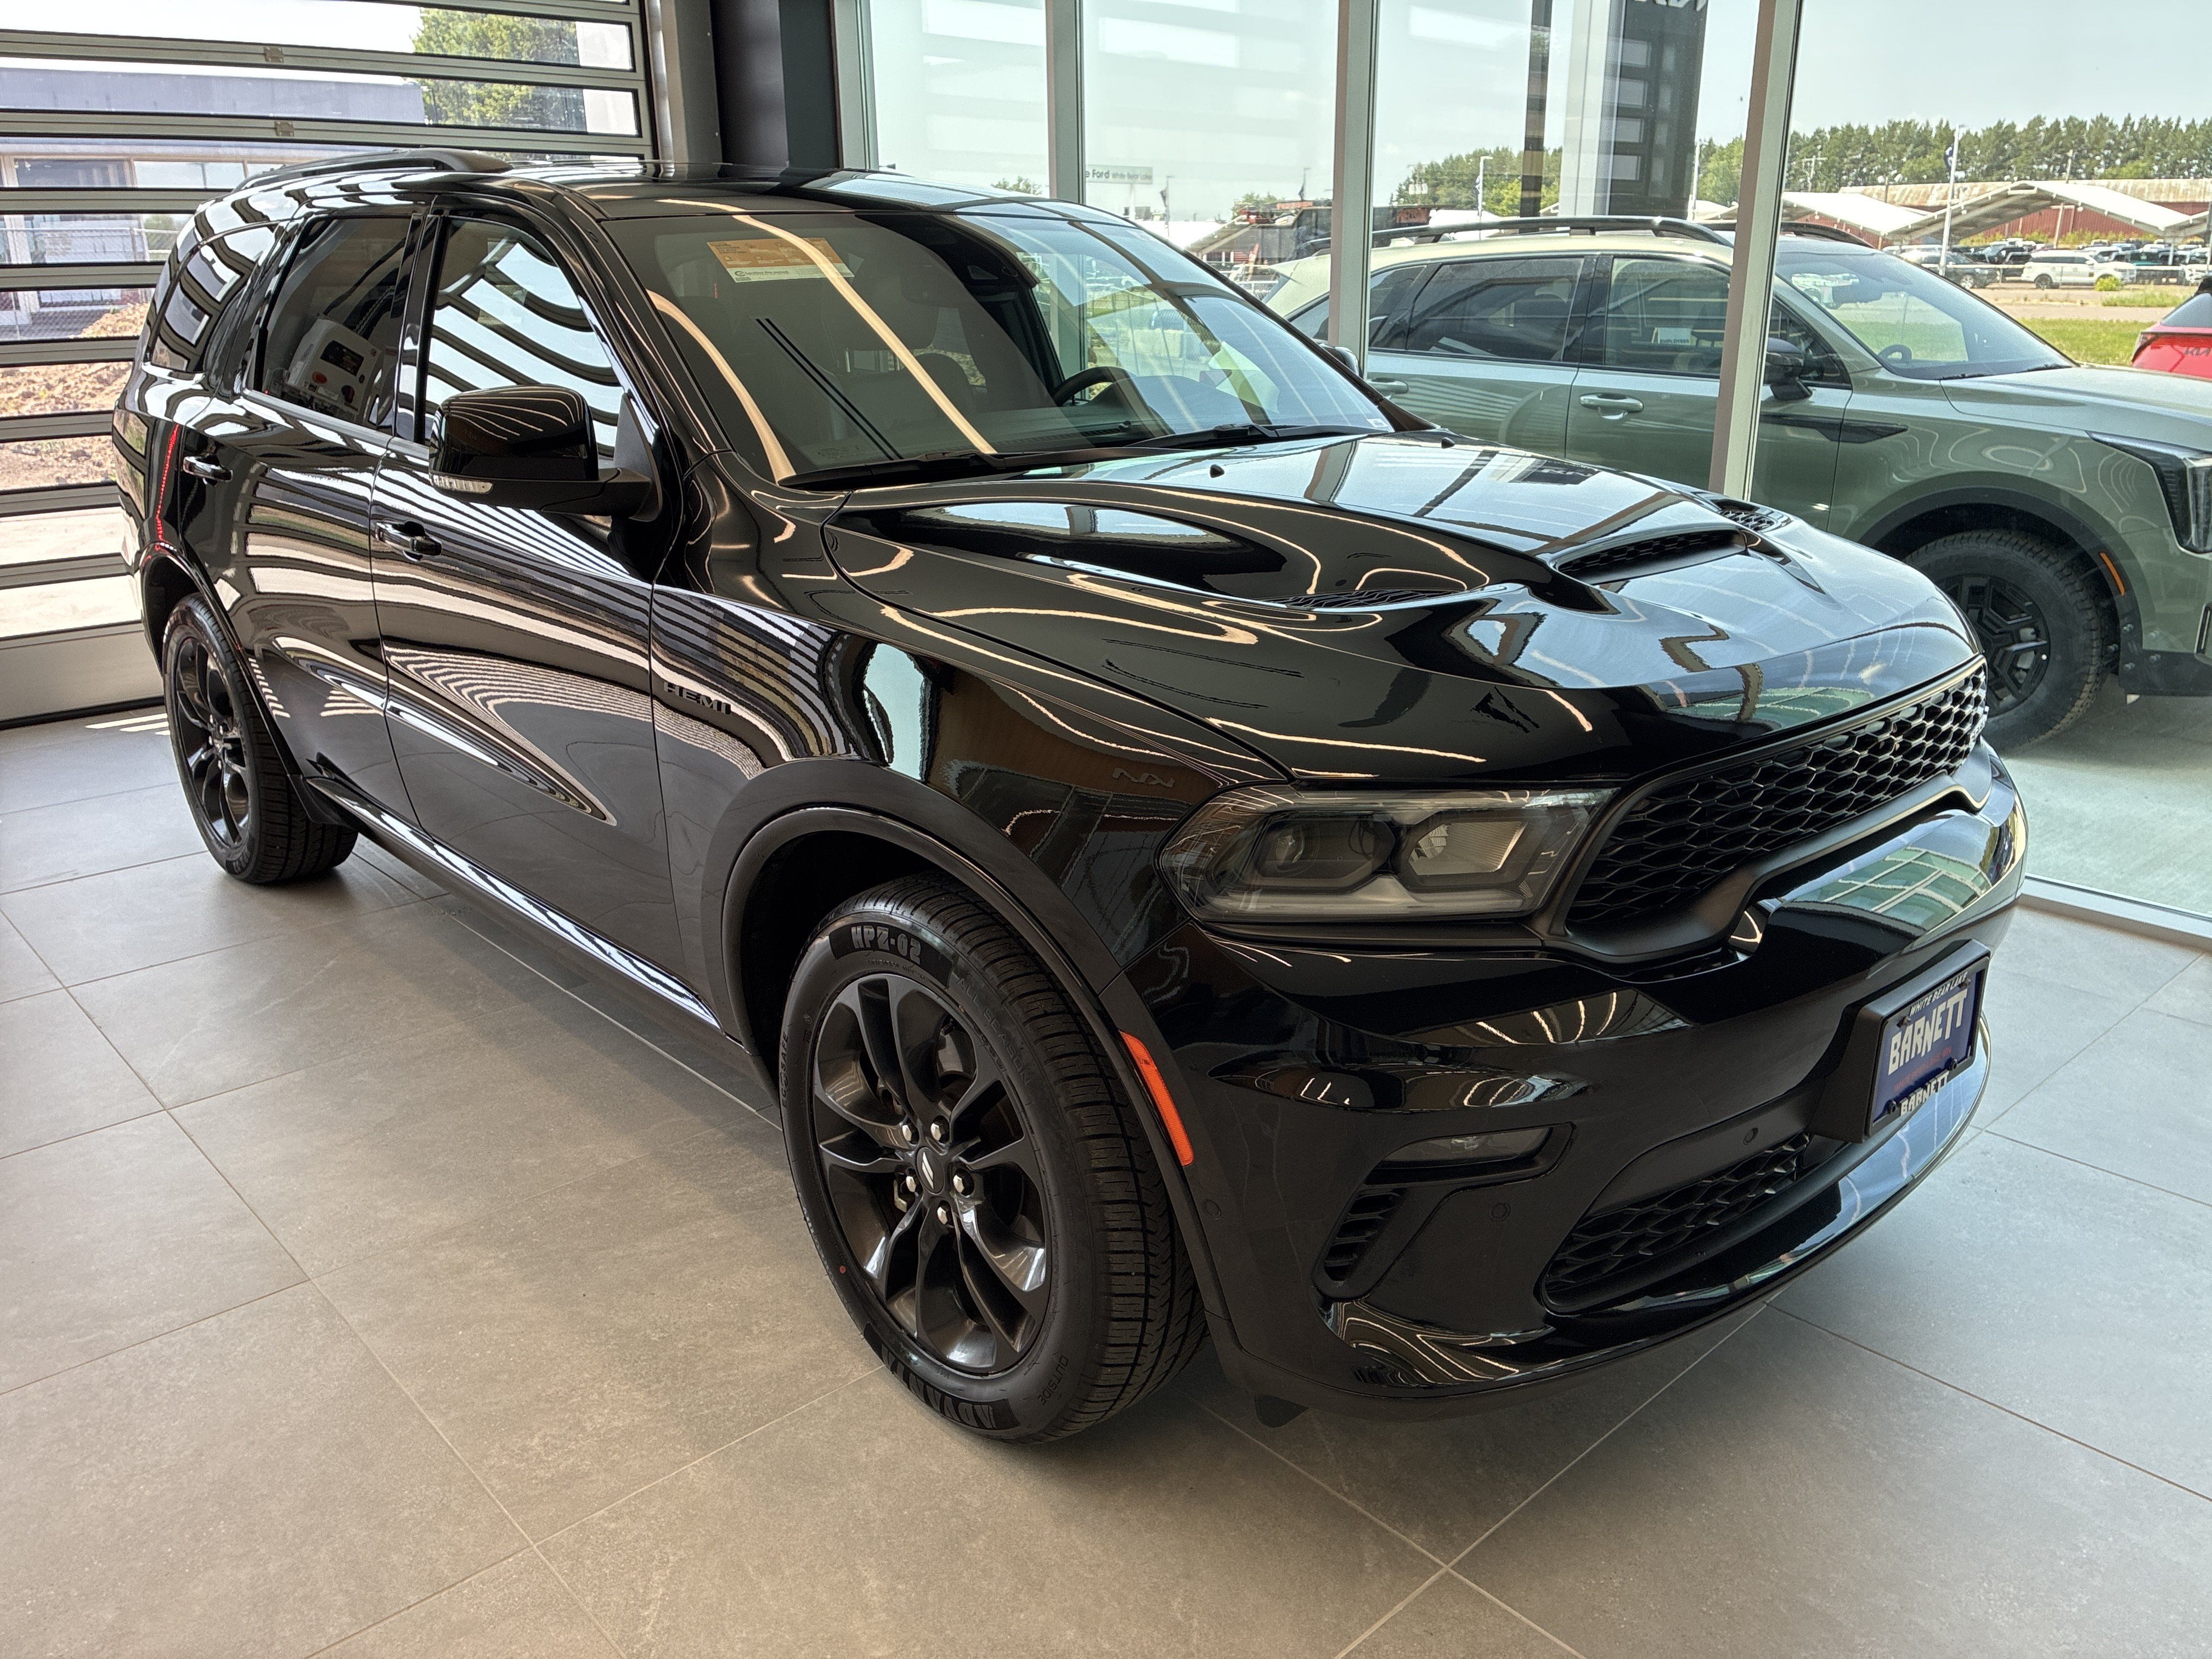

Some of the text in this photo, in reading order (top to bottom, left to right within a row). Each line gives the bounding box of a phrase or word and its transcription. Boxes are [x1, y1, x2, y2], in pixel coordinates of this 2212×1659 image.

[1092, 169, 1110, 178] Ford
[664, 681, 731, 715] HEMI
[851, 926, 921, 964] HPZ-02
[1910, 972, 1968, 1017] WHITE BEAR LAKE
[956, 977, 1030, 1086] ALL SEASON
[1888, 988, 1968, 1076] BARNETT
[1900, 1071, 1949, 1115] BARNETT
